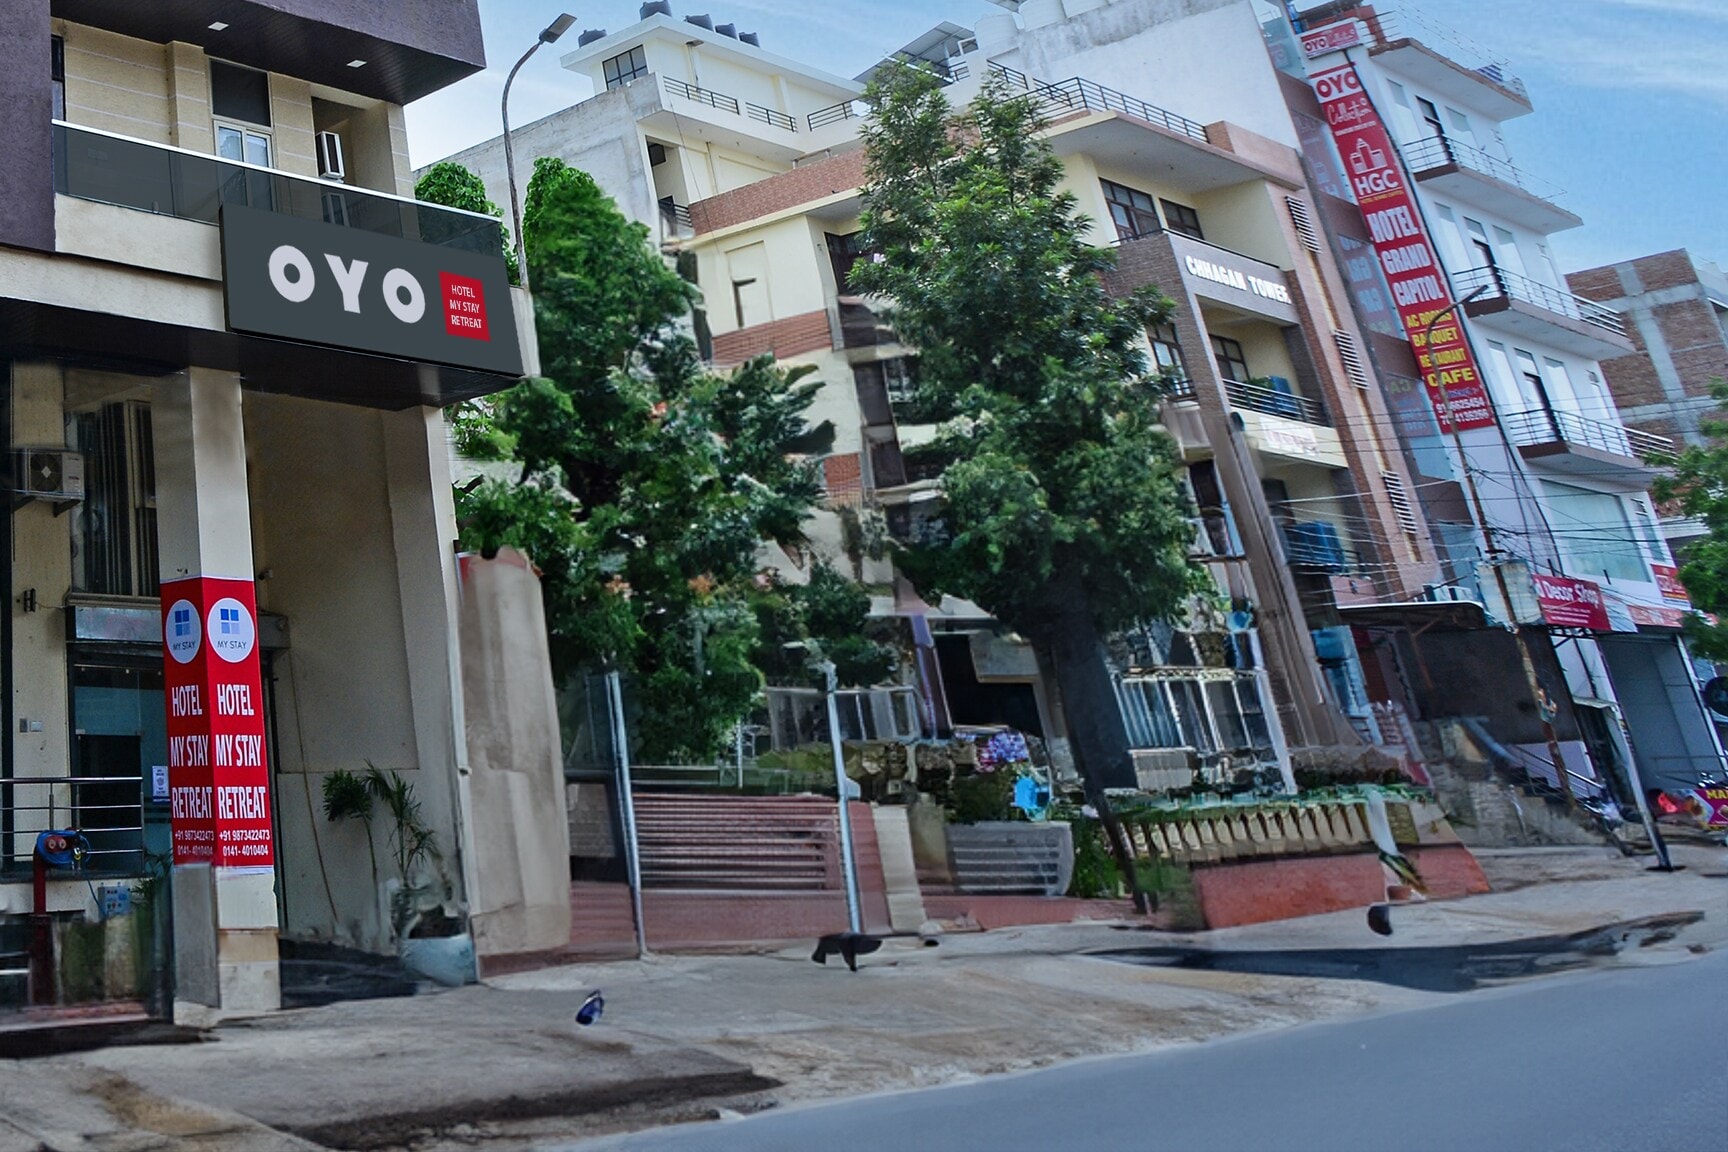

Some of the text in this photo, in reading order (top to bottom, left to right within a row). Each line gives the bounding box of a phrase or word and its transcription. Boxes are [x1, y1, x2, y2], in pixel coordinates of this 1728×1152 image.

[1304, 38, 1326, 52] OYO
[1316, 71, 1361, 98] OYO
[1354, 169, 1399, 196] HGC
[1366, 205, 1420, 243] HOTEL
[1381, 243, 1431, 275] GRAND
[268, 245, 425, 324] OYO
[452, 284, 475, 298] HOTEL
[1393, 275, 1445, 307] CAPITOL
[450, 299, 480, 313] MY STAY
[451, 314, 482, 328] RETREAT
[1406, 314, 1420, 328] AC
[1419, 348, 1467, 368] RETAURANT
[1426, 367, 1475, 387] CAFE
[173, 641, 196, 651] MY STAY
[217, 641, 247, 650] MY STAY
[172, 684, 203, 717] HOTEL
[216, 683, 255, 716] HOTEL
[171, 735, 209, 767] MY STAY
[215, 734, 262, 767] MY STAY
[172, 786, 212, 819] RETREAT
[217, 786, 266, 819] RETREAT
[219, 829, 270, 841] +91 9873422473
